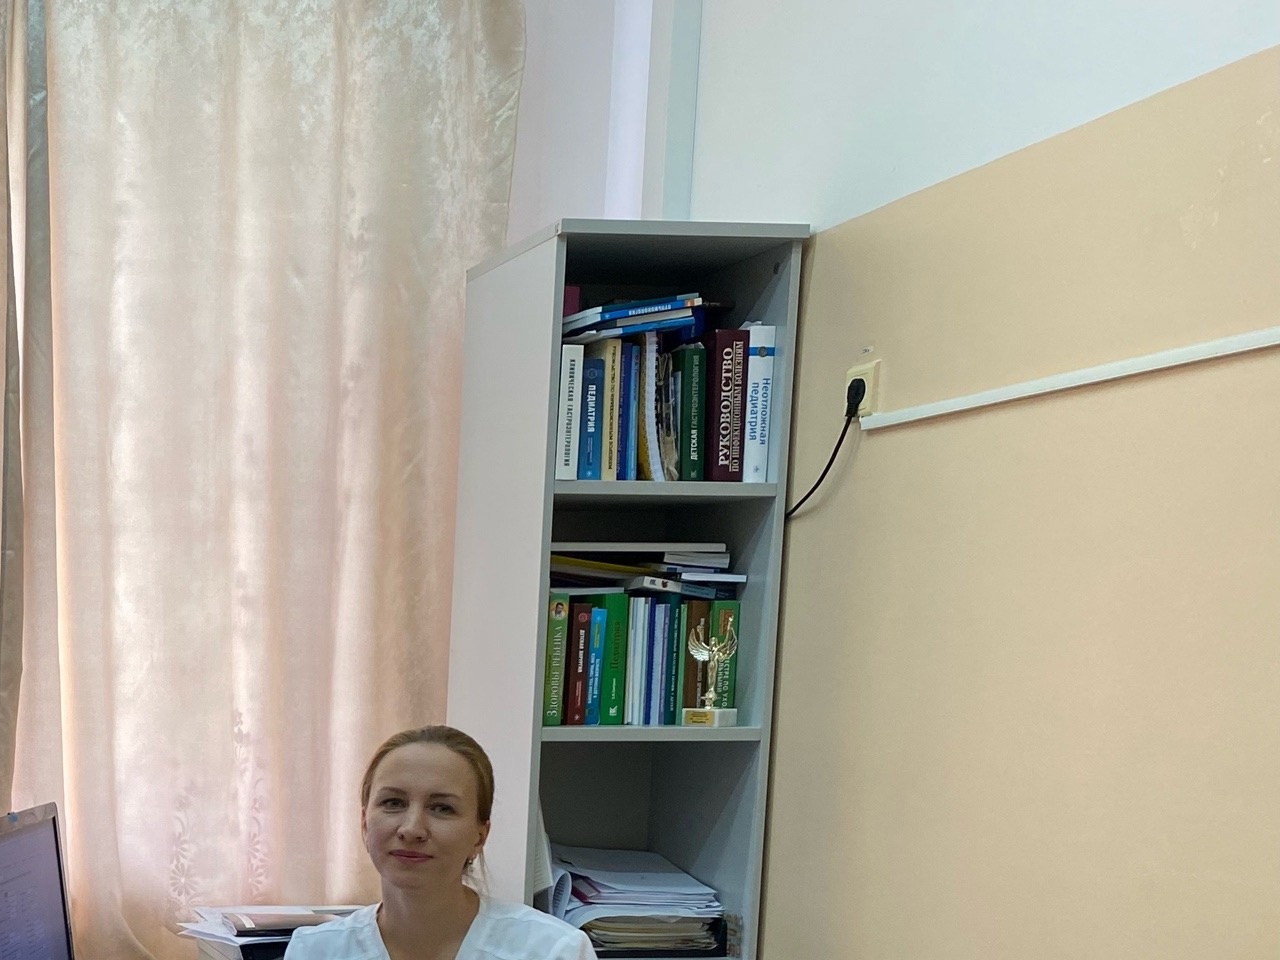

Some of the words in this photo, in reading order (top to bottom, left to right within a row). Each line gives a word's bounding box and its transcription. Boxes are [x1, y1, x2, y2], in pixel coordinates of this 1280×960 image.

[567, 359, 576, 402] КЛИНИЧЕСКАЯ
[734, 341, 744, 385] БОЛЕЗНЯМ
[586, 384, 597, 433] ПЕДИАТРИЯ
[691, 355, 700, 429] ГАСТРОЭНТЕРОЛОГИЯ
[718, 347, 733, 466] РУКОВОДСТВО
[748, 382, 760, 441] педиатрия
[760, 377, 771, 445] Неотложная
[563, 404, 574, 467] ГАСТРОЭНТЕРОЛОГИЯ
[690, 429, 698, 461] ДЕТСКАЯ
[732, 386, 742, 458] ИНФЕКЦИОННЫМ
[731, 459, 740, 472] ПО
[609, 621, 622, 669] Педиатрия
[716, 660, 724, 693] ОЛЬНЫМИ
[722, 680, 729, 691] ПО
